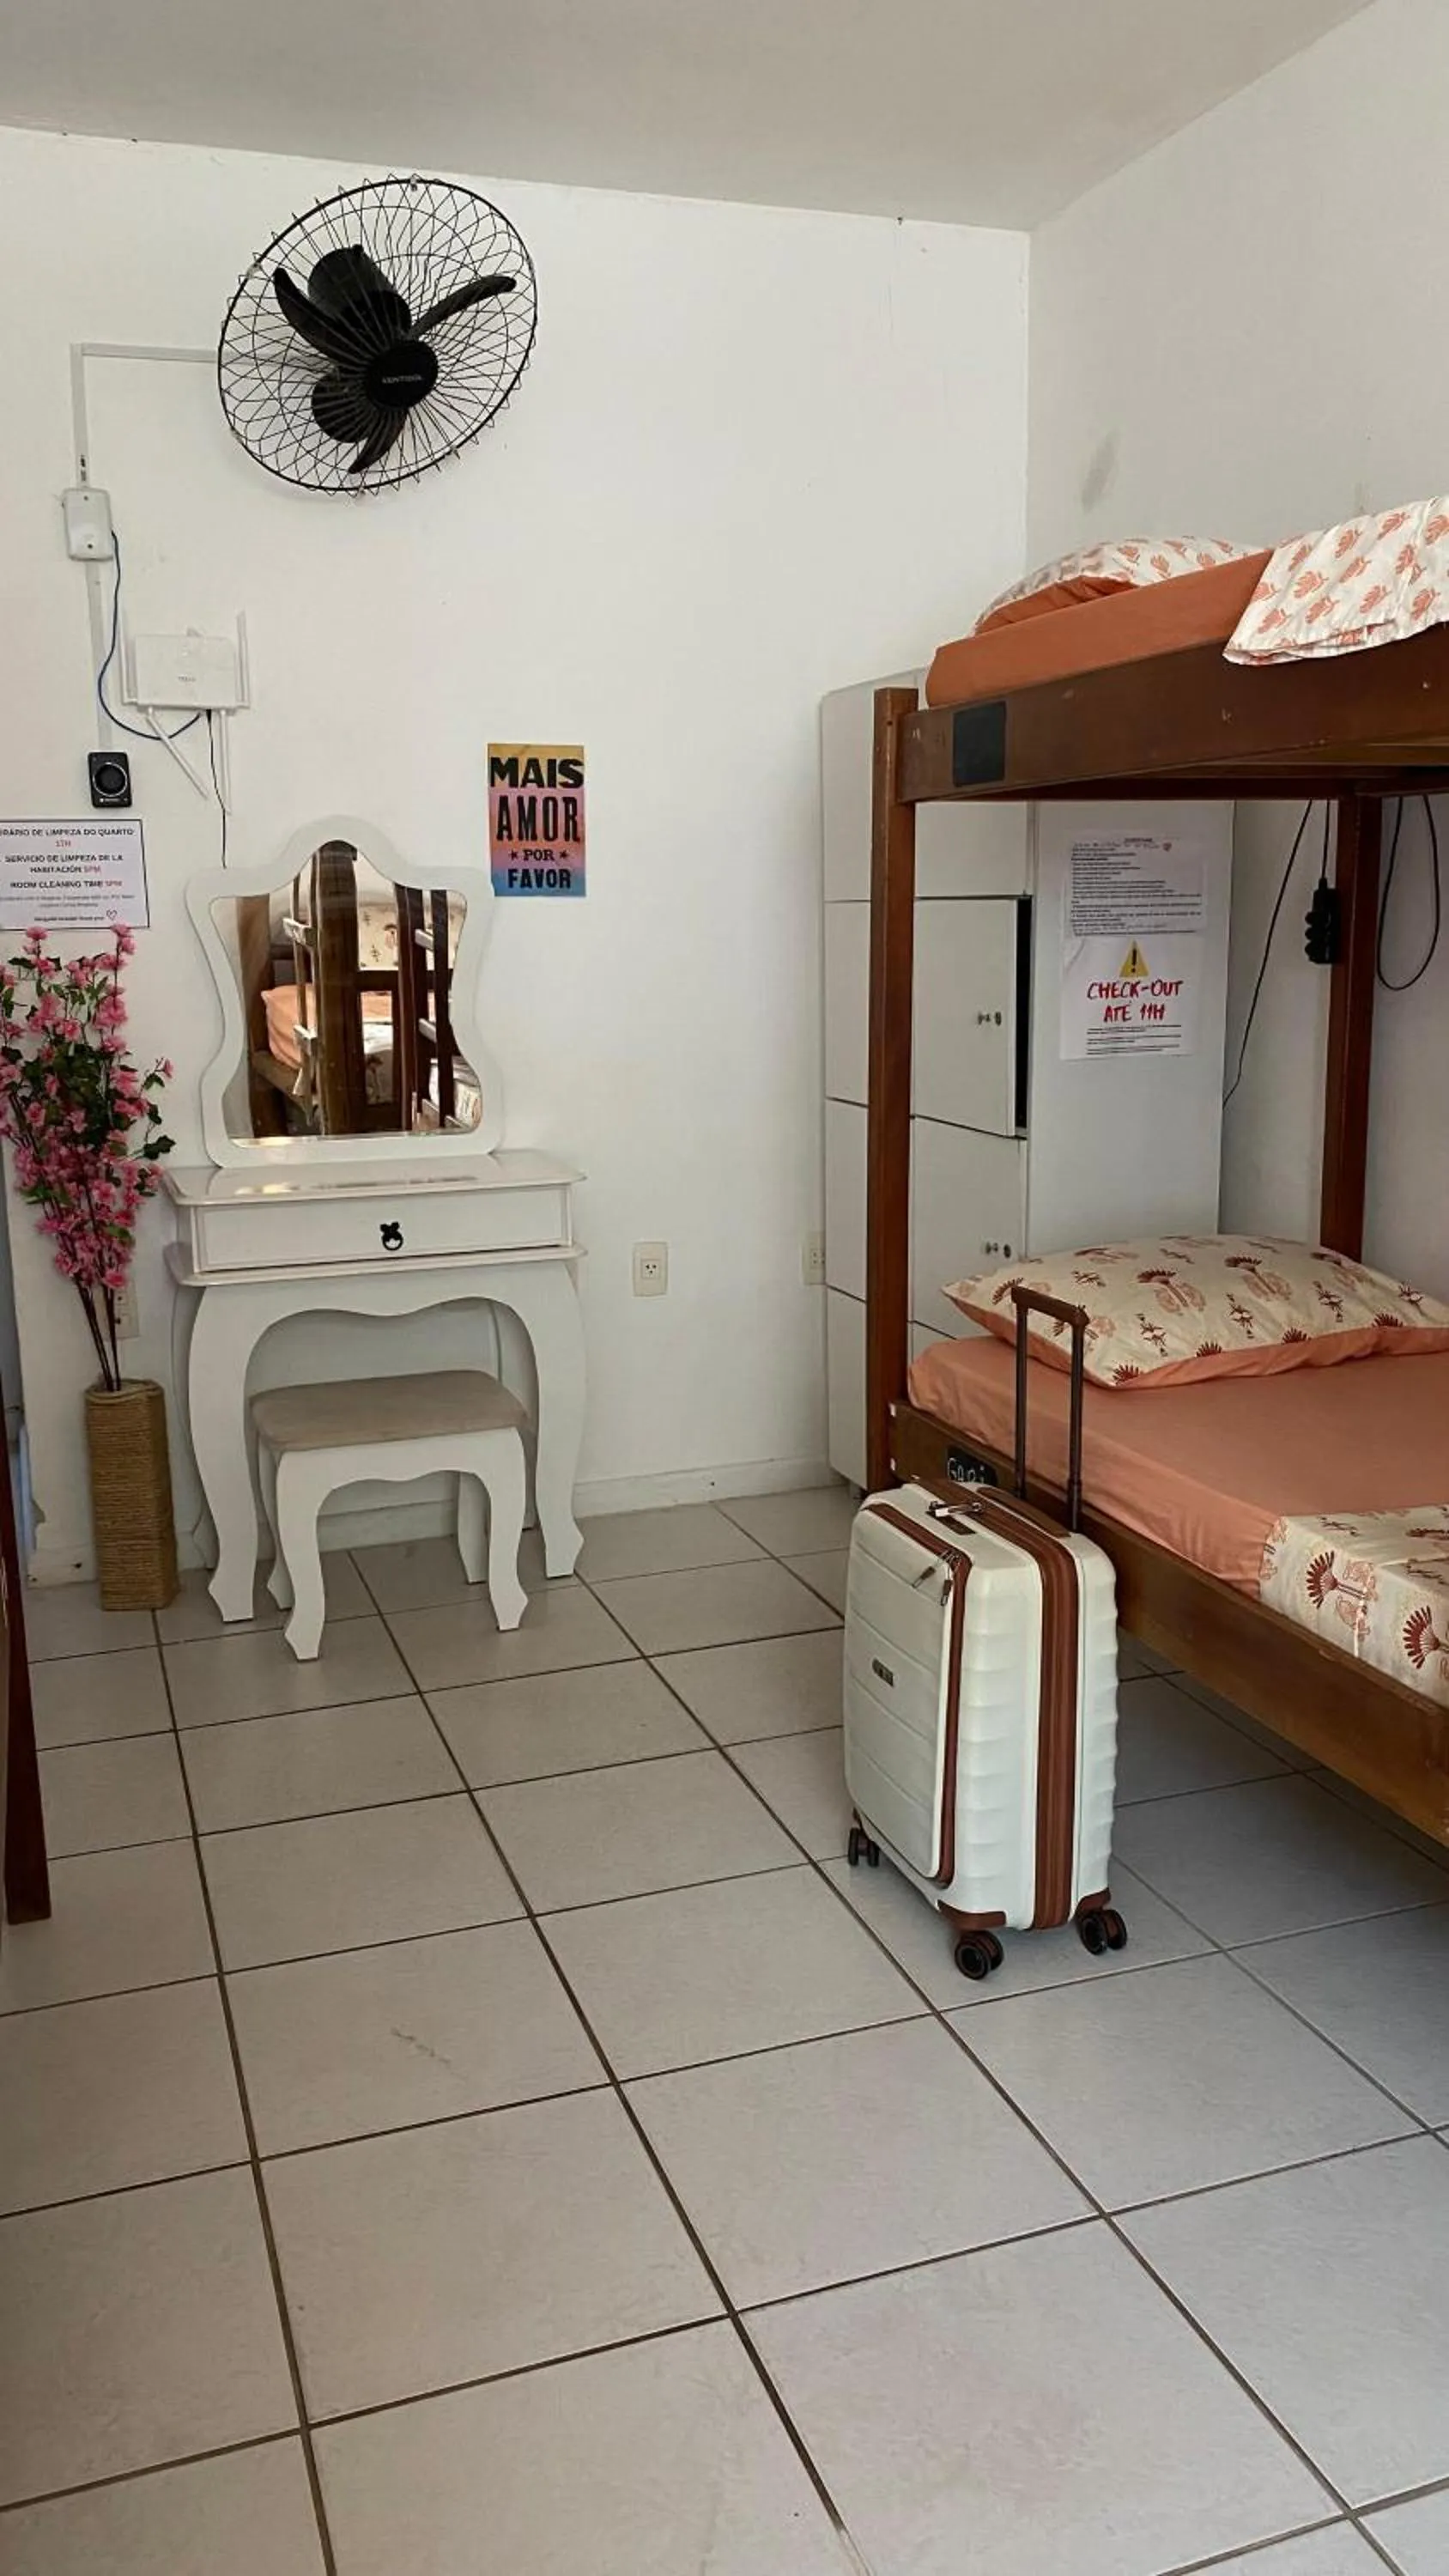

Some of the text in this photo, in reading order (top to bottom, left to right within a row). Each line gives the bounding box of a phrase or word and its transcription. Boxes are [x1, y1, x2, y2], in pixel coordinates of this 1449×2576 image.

[489, 757, 584, 788] MAIS
[495, 795, 580, 843] AMOR
[98, 828, 135, 837] QUARTO
[523, 849, 555, 860] POR
[39, 880, 82, 889] CLEANING
[507, 868, 571, 890] FAVOR
[1087, 979, 1184, 999] CHECK-OUT
[1140, 1003, 1166, 1021] 11H
